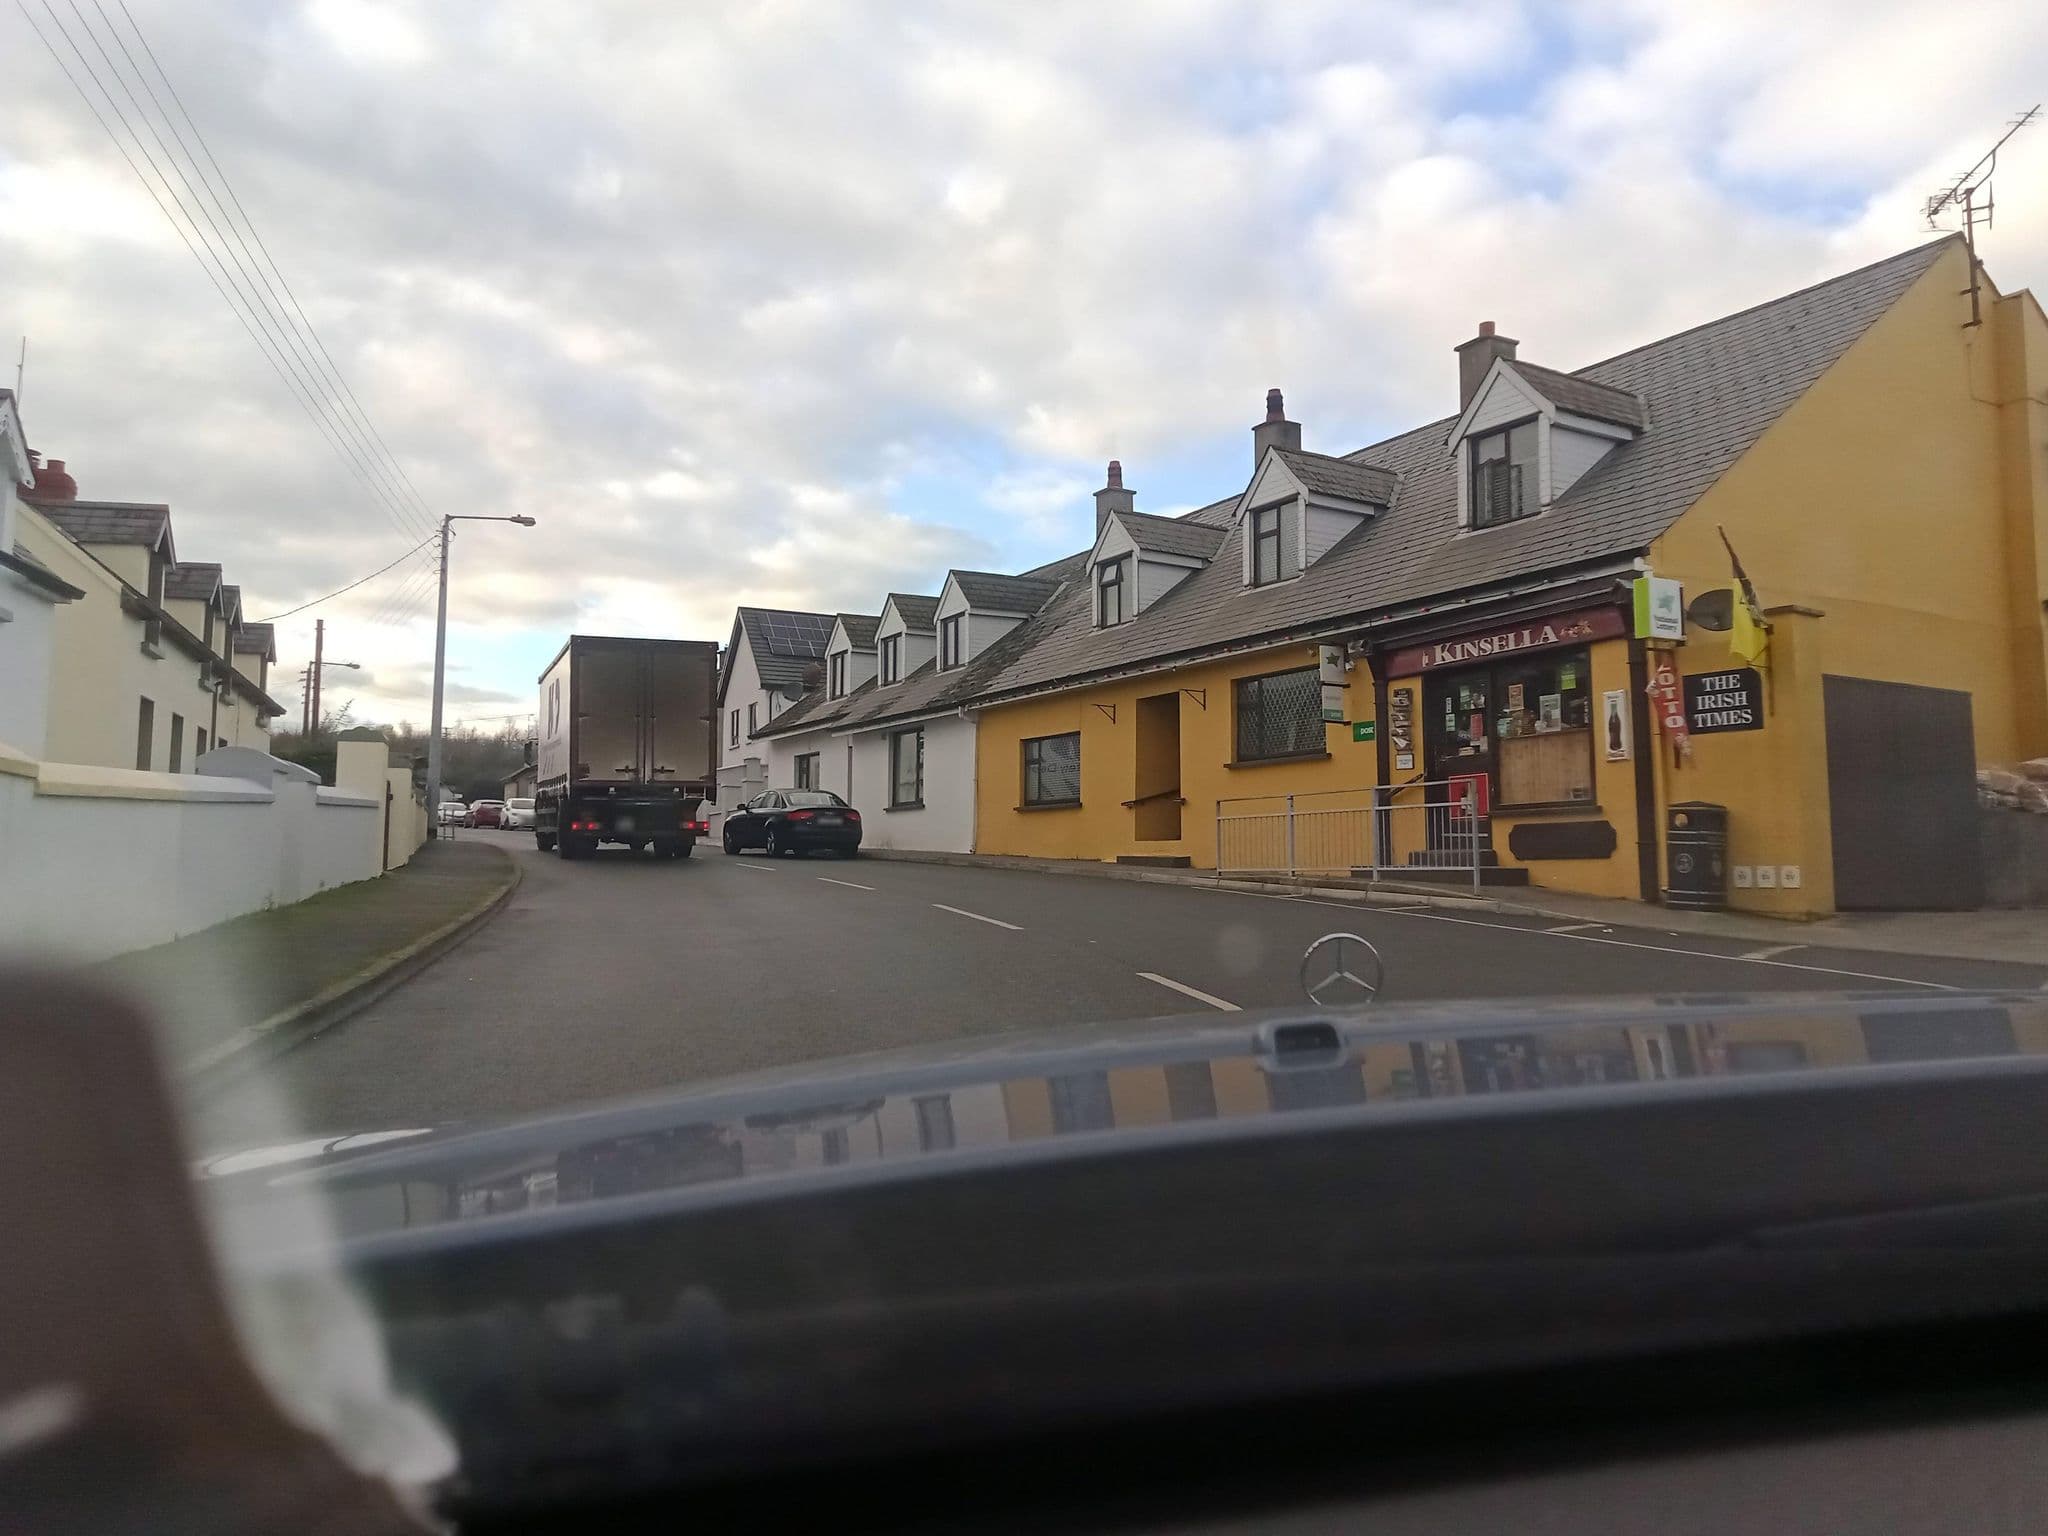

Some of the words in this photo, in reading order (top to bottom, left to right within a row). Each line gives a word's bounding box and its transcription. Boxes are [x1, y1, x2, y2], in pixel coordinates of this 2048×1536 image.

[1433, 625, 1559, 666] KINSELLA
[1701, 674, 1741, 692] THE
[1696, 691, 1749, 710] IRISH
[1694, 709, 1753, 729] TIMES
